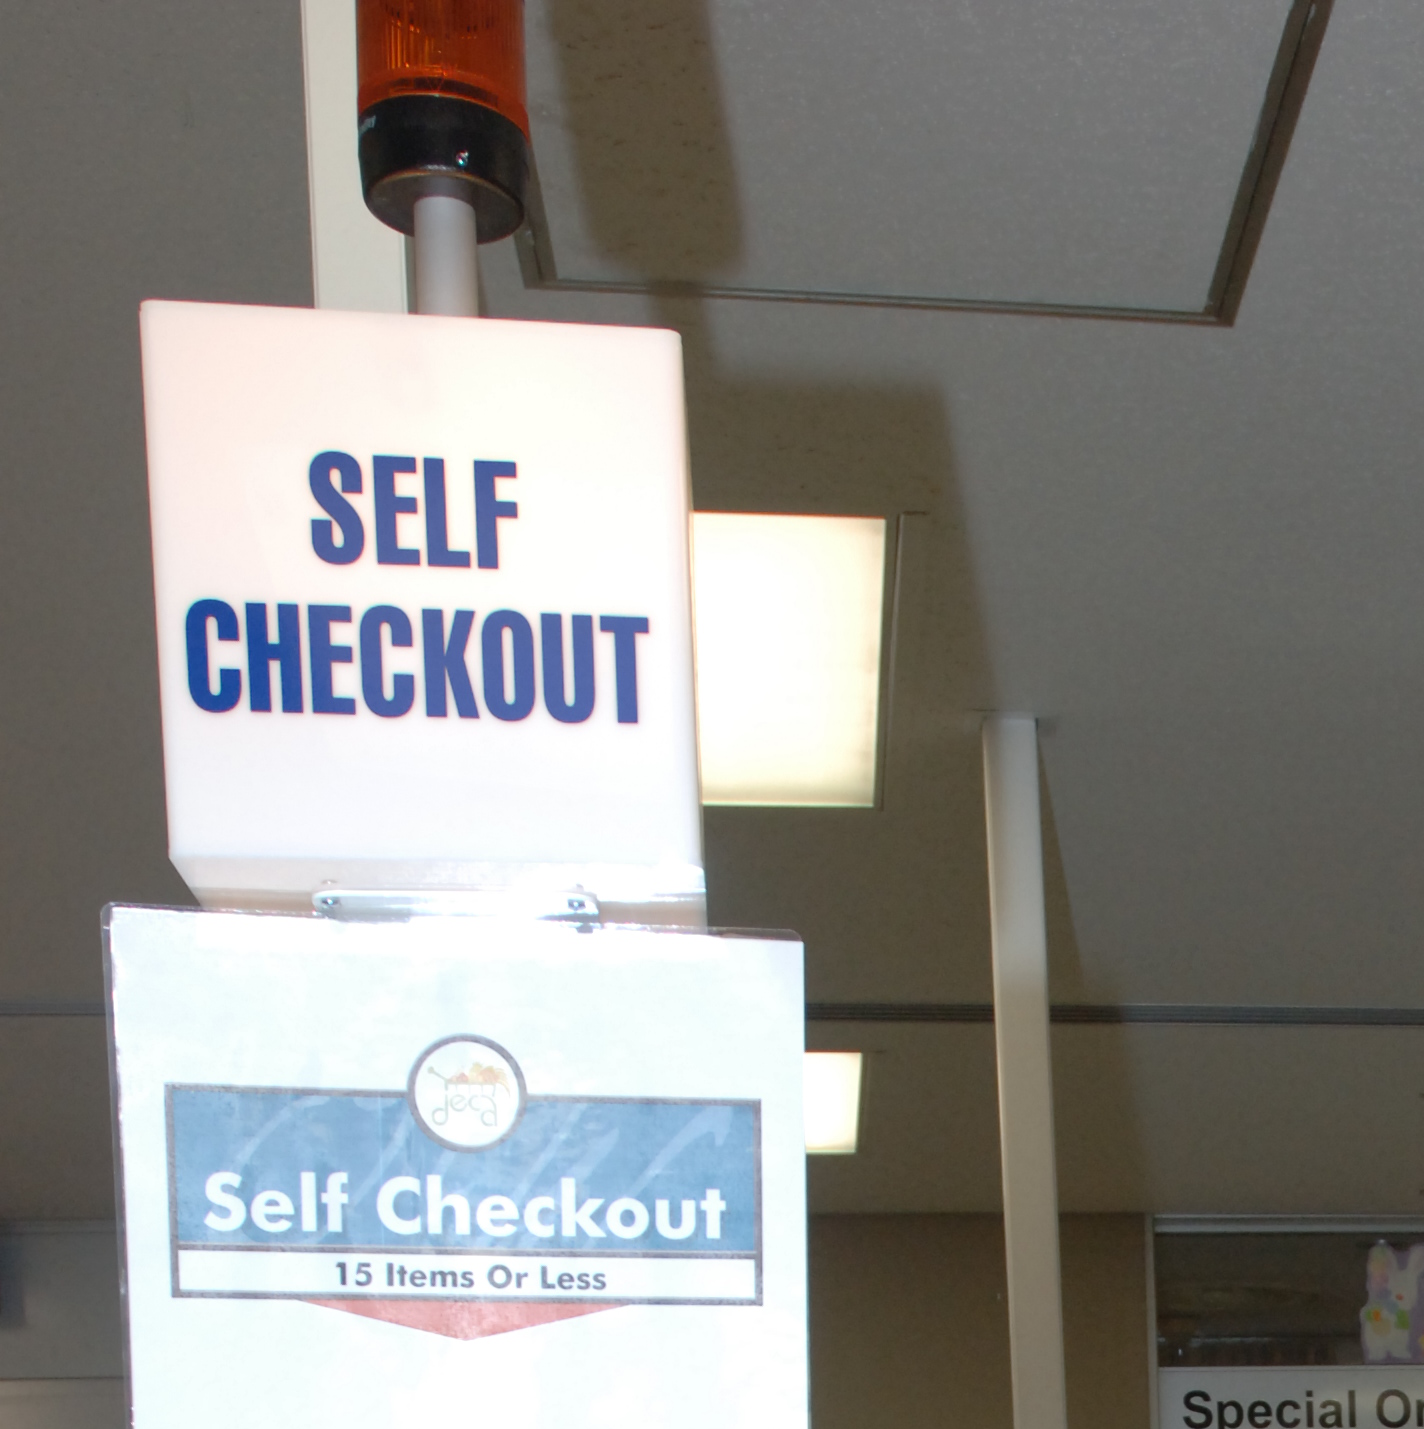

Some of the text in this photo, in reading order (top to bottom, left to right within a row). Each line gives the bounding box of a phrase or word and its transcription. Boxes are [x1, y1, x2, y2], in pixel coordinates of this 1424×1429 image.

[308, 450, 519, 570] SELF
[185, 598, 651, 726] CHECKOUT
[203, 1171, 727, 1241] Self Checkout
[335, 1261, 607, 1292] 15 Items Or Less
